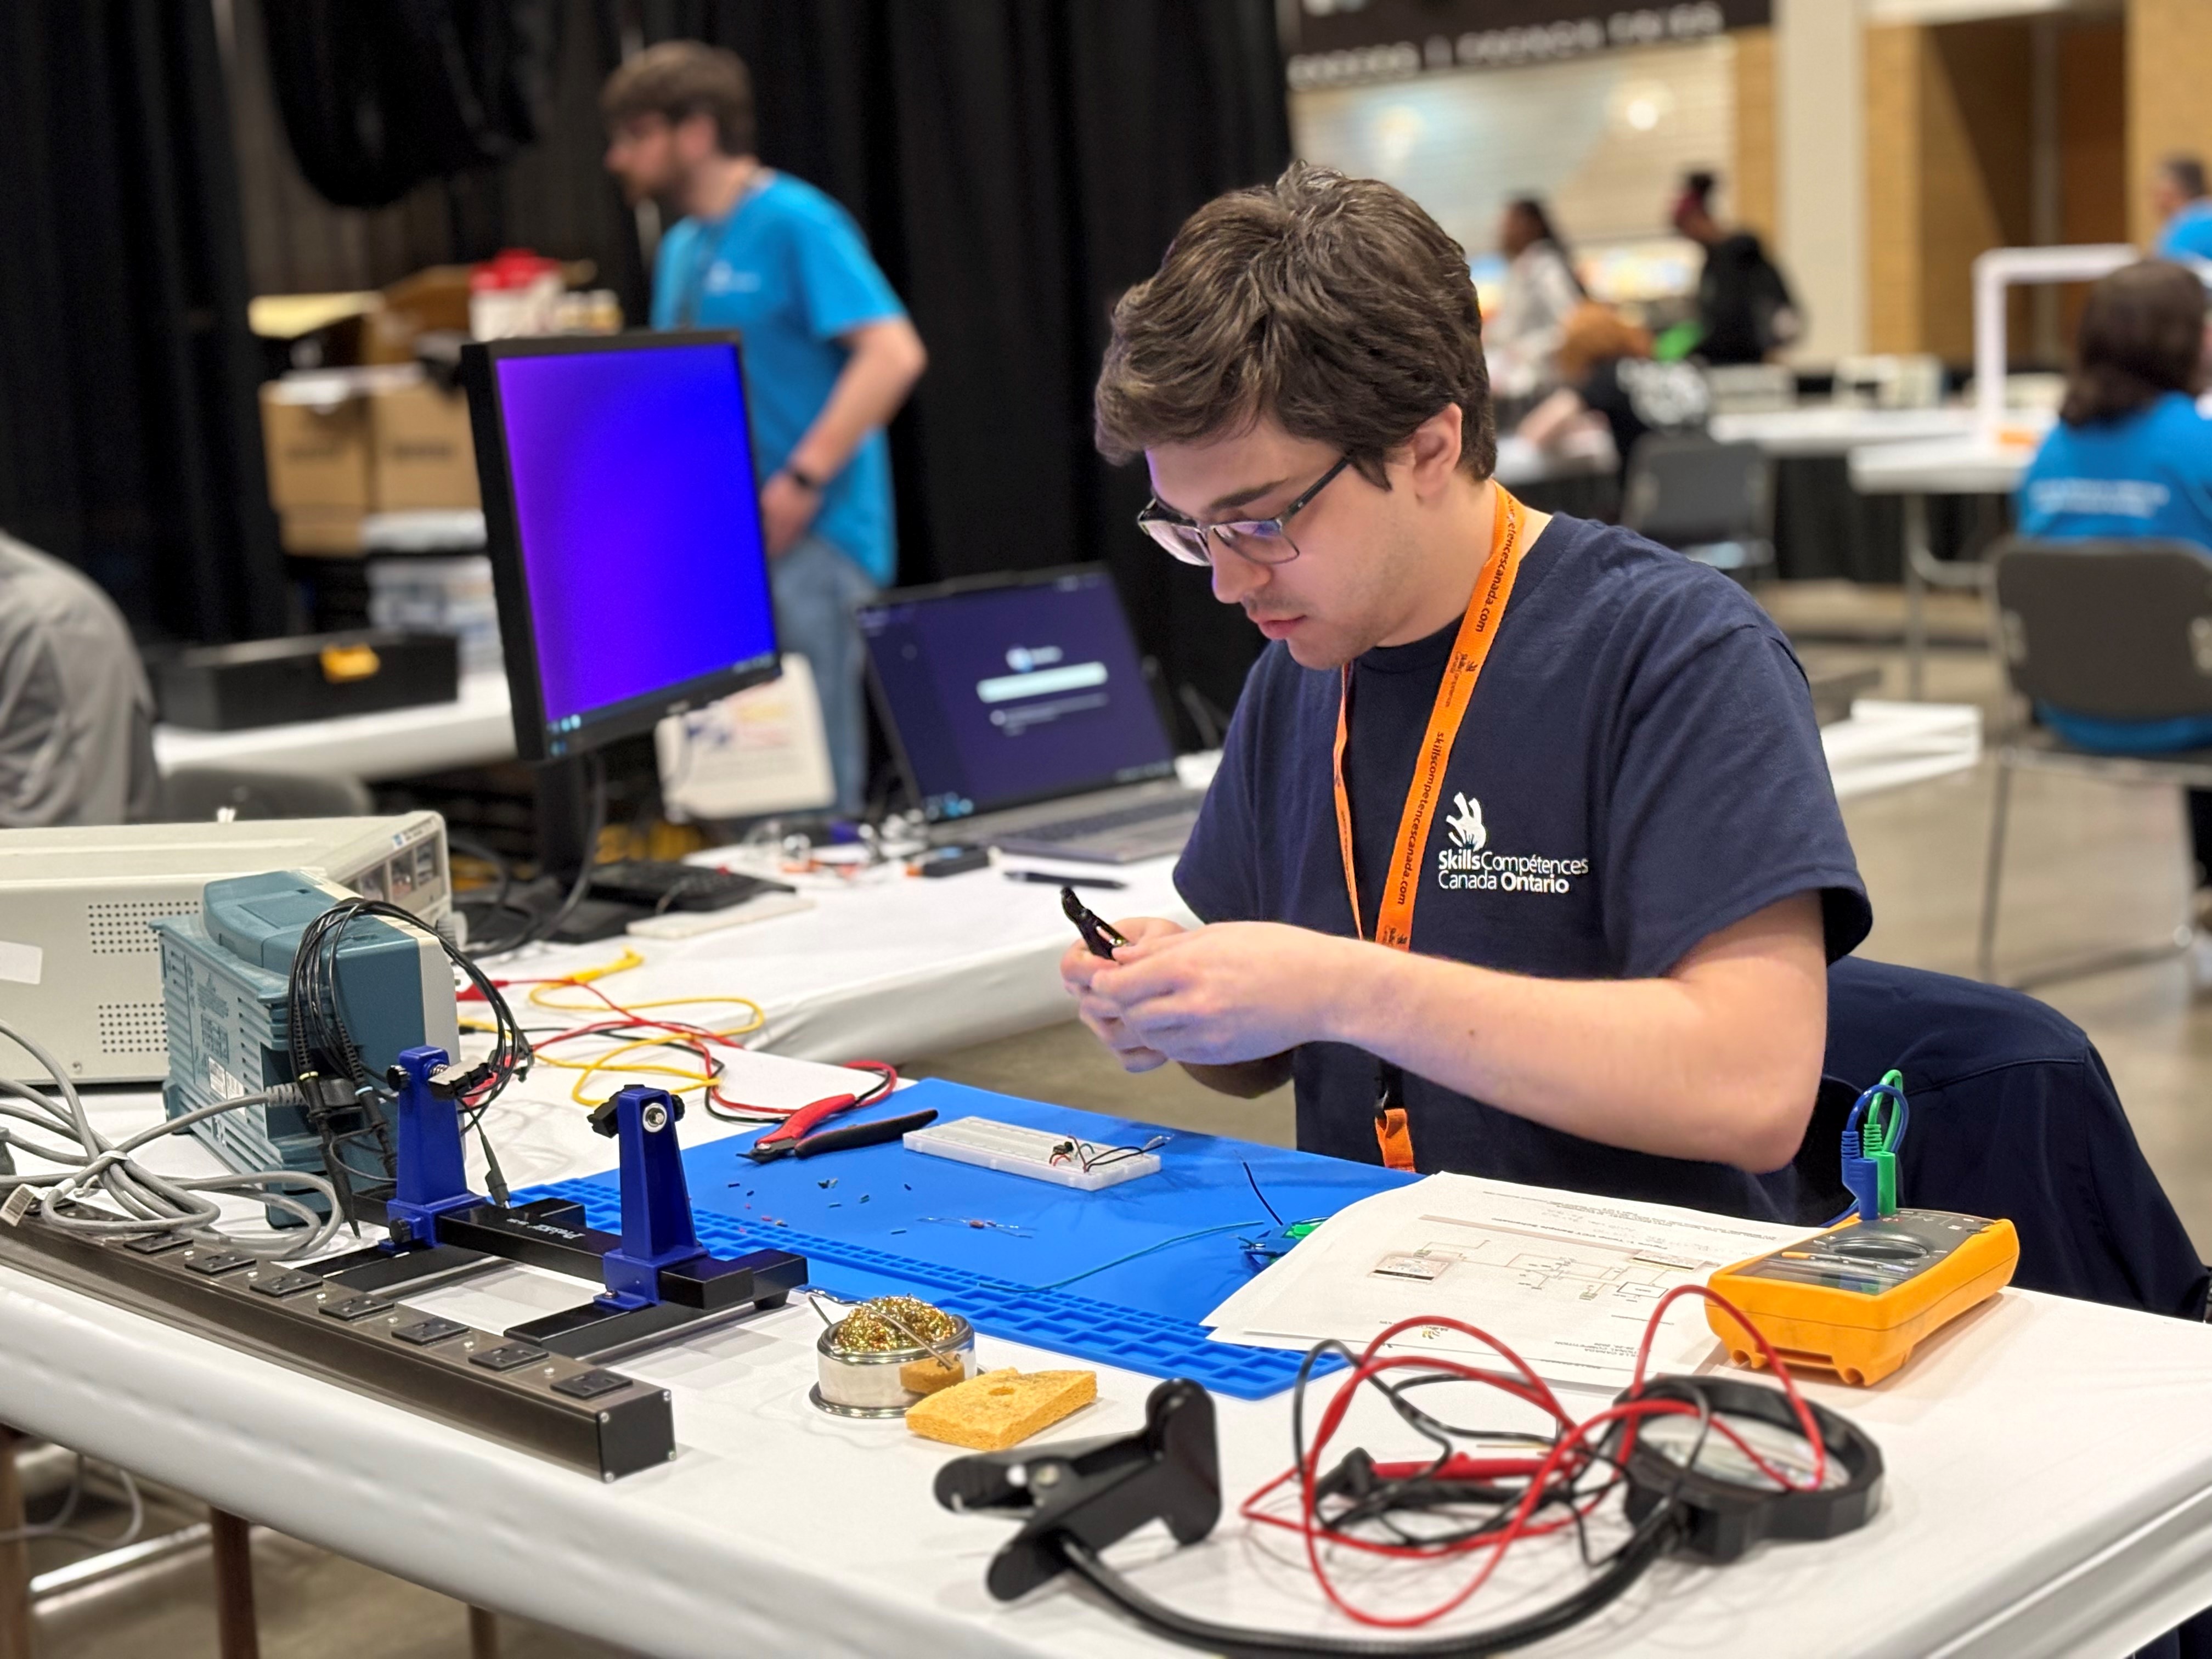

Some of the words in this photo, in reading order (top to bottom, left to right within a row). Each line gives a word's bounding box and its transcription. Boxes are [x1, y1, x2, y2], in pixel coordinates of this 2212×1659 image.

[1397, 731, 1444, 905] skillscompetencescanada.com
[1438, 870, 1497, 890] Canada
[1500, 871, 1570, 894] Ontario
